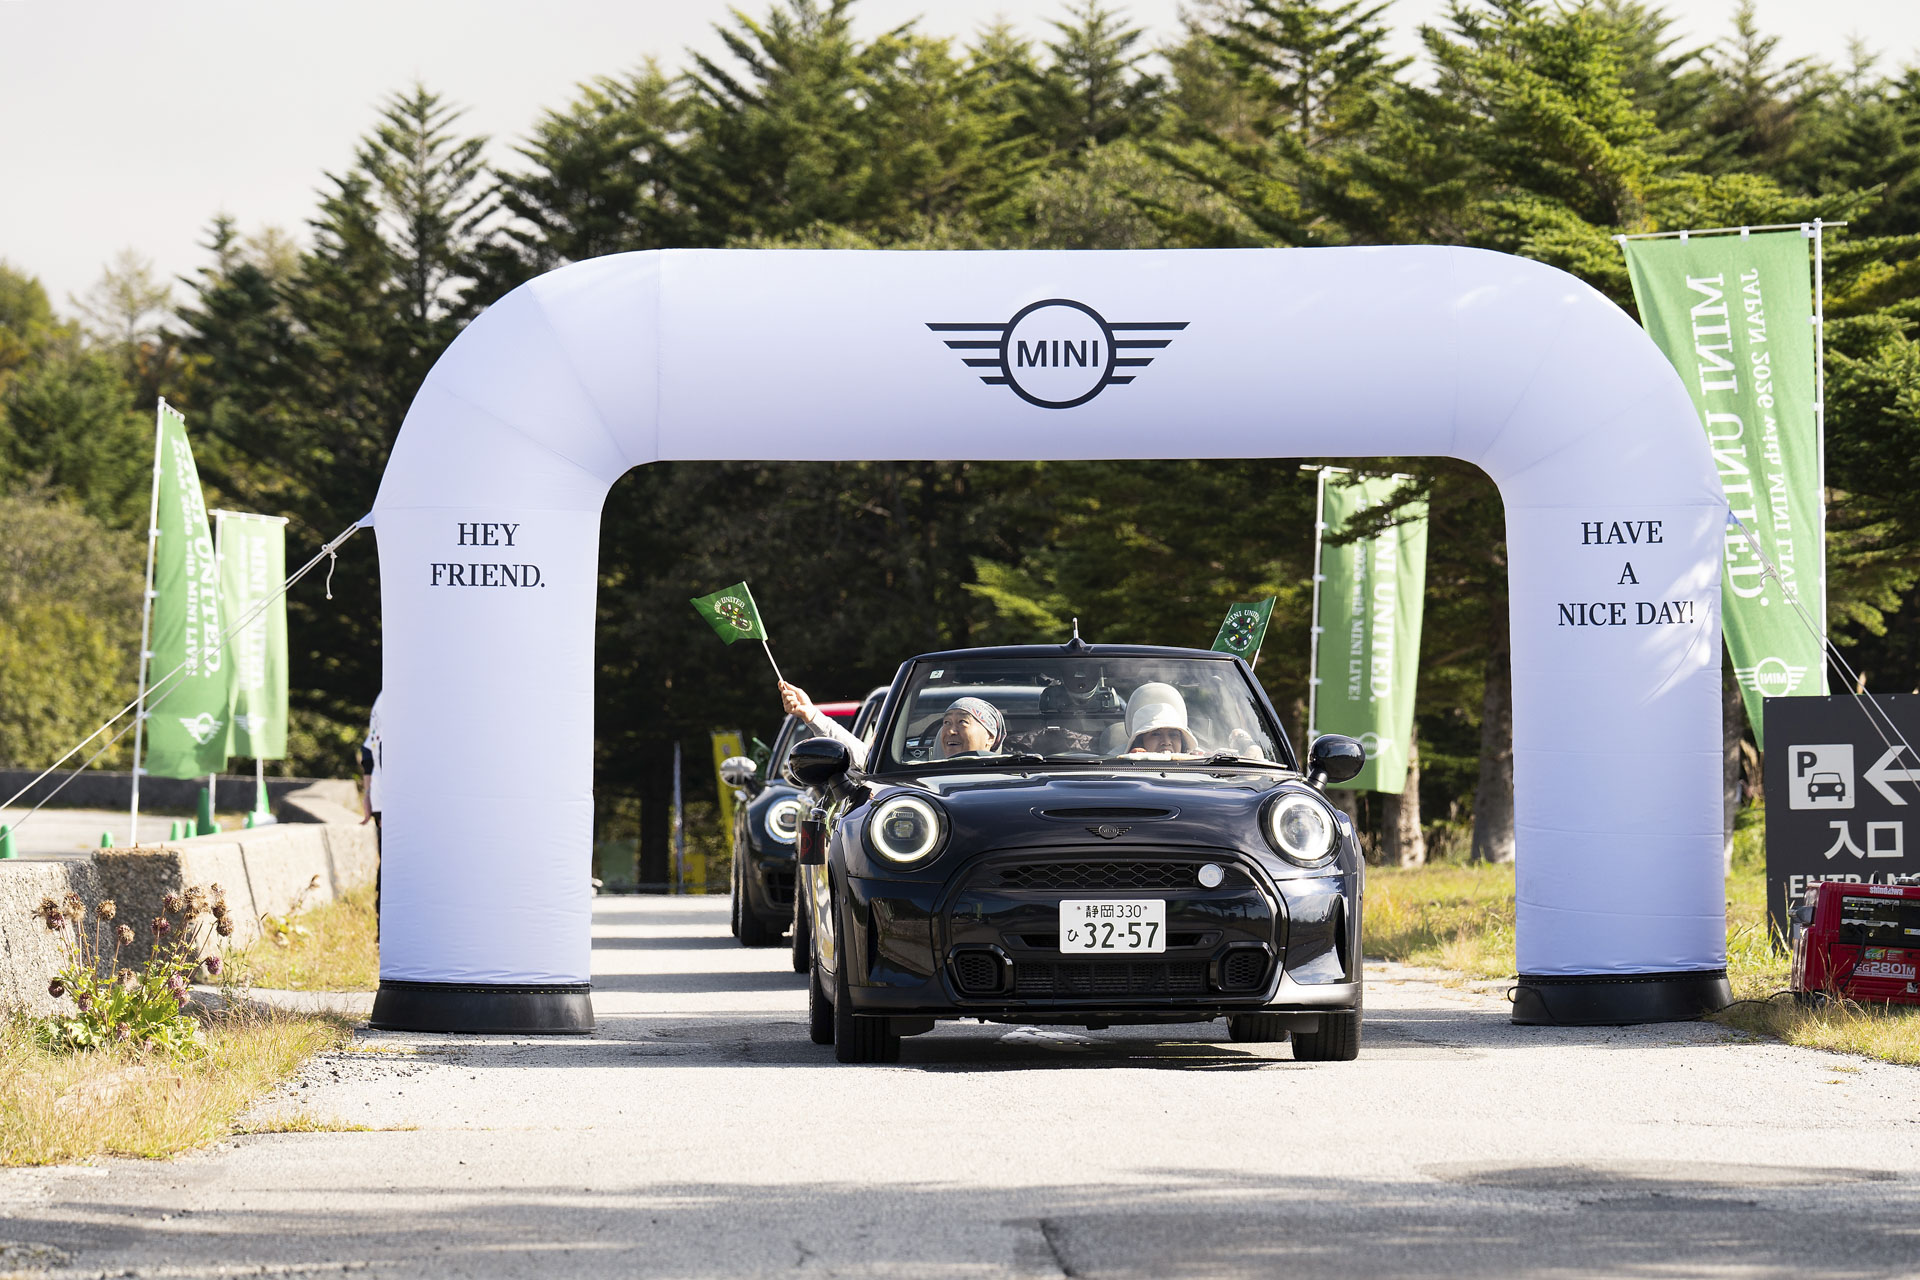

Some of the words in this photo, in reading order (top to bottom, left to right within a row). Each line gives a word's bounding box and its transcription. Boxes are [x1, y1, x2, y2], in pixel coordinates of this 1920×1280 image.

[1017, 340, 1099, 368] MINI
[457, 522, 520, 546] HEY
[1581, 520, 1663, 545] HAVE
[430, 563, 545, 588] FRIEND.
[1617, 561, 1640, 585] A
[1557, 602, 1627, 626] NICE
[1635, 600, 1694, 625] DAY!
[1350, 619, 1363, 656] MINI
[1369, 582, 1396, 703] UNITED.
[1348, 659, 1362, 701] LIVE!
[1796, 751, 1818, 777] P
[1823, 820, 1904, 860] 入口
[1067, 929, 1080, 942] ひ
[1083, 922, 1159, 949] 32-57
